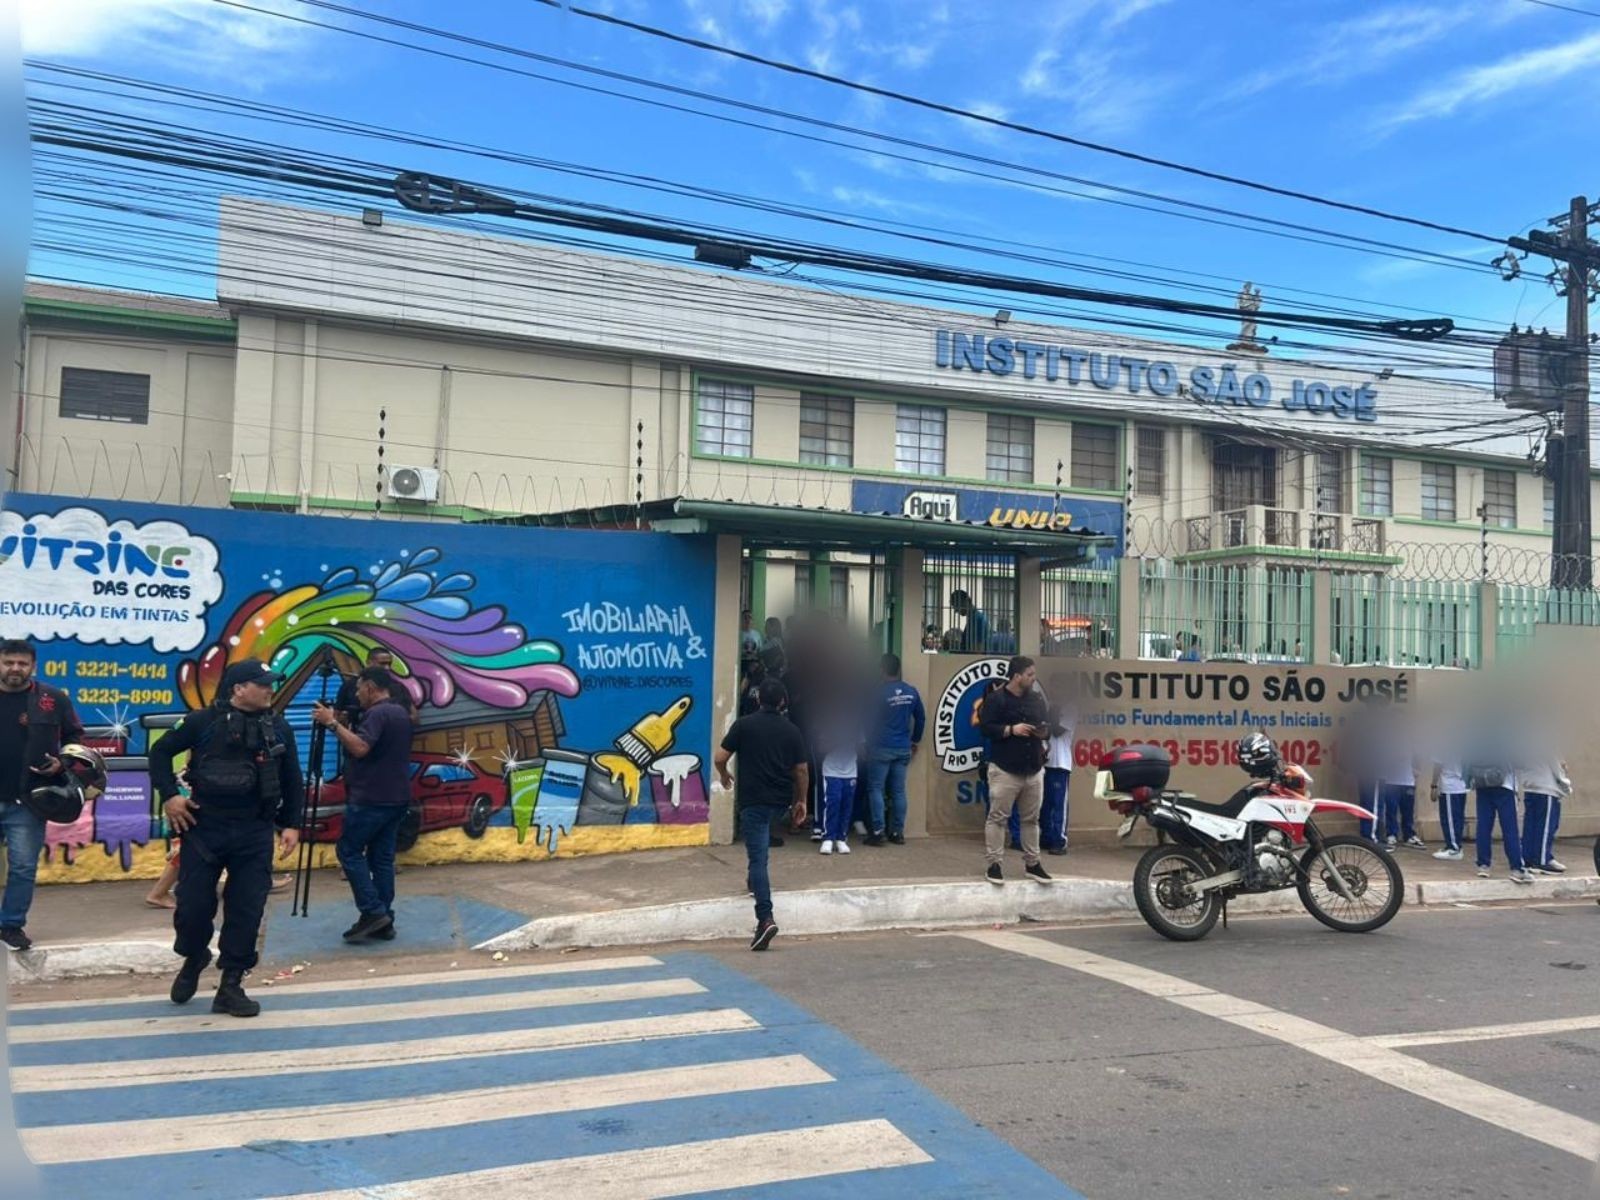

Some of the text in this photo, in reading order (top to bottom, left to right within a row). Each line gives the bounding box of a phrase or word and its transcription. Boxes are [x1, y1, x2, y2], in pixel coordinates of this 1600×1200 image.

[935, 329, 1377, 422] INSTITUTO SÃO JOSÉ
[93, 580, 191, 599] DAS CORES
[100, 606, 128, 620] EM
[132, 607, 189, 622] TINTAS
[562, 602, 707, 660] IMOBILIARIA &
[578, 642, 683, 669] AUTOMOTIVA
[75, 661, 167, 679] 3221-1414
[1076, 669, 1408, 703] NSTITUTO SÃO JOSÉ
[77, 688, 173, 705] 3223-8990
[938, 662, 992, 745] INSTITUTO
[1132, 709, 1237, 727] Fundamental
[1281, 710, 1332, 727] Iniciais
[948, 754, 968, 766] RIO
